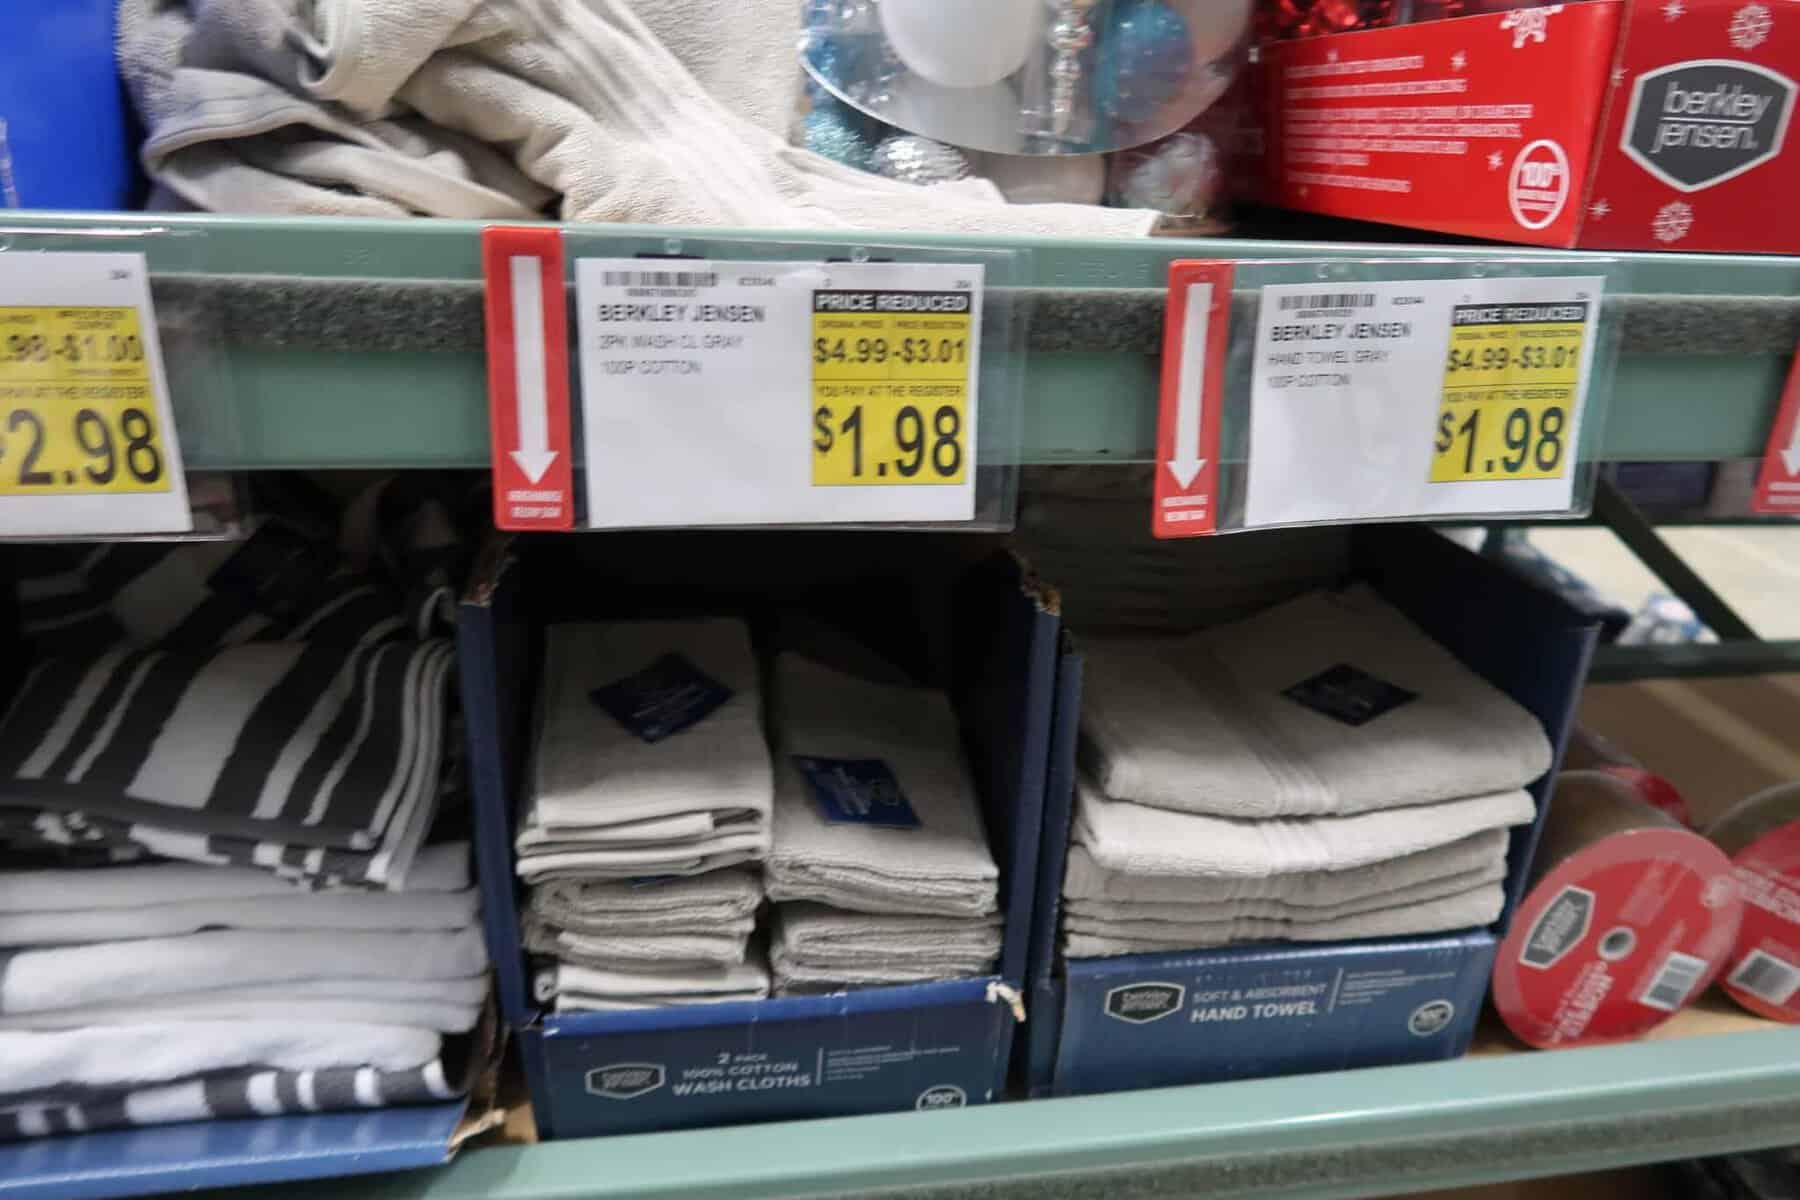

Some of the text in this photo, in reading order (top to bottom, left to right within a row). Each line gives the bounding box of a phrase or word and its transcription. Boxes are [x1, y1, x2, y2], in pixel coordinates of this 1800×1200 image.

[1664, 81, 1773, 123] berkley
[816, 294, 969, 311] PRICE REDUCED
[599, 304, 766, 322] BERKLEY JENSEN
[1456, 306, 1586, 323] PRICE REDUCED
[1271, 323, 1412, 341] BERKLEY JENSEN
[631, 335, 675, 350] WASH
[1307, 351, 1349, 364] TOWEL
[640, 360, 702, 374] COTTON
[1296, 374, 1350, 387] COTTON
[0, 408, 162, 485] 2.98
[814, 404, 961, 478] $1.98
[1435, 406, 1565, 474] $1.98
[1246, 983, 1327, 999] ABSORBENT
[1190, 1005, 1247, 1023] HAND
[1252, 1001, 1319, 1019] TOWEL
[717, 1051, 731, 1064] 2
[727, 1061, 799, 1076] COTTON
[672, 1074, 812, 1096] WASH CLOTHS
